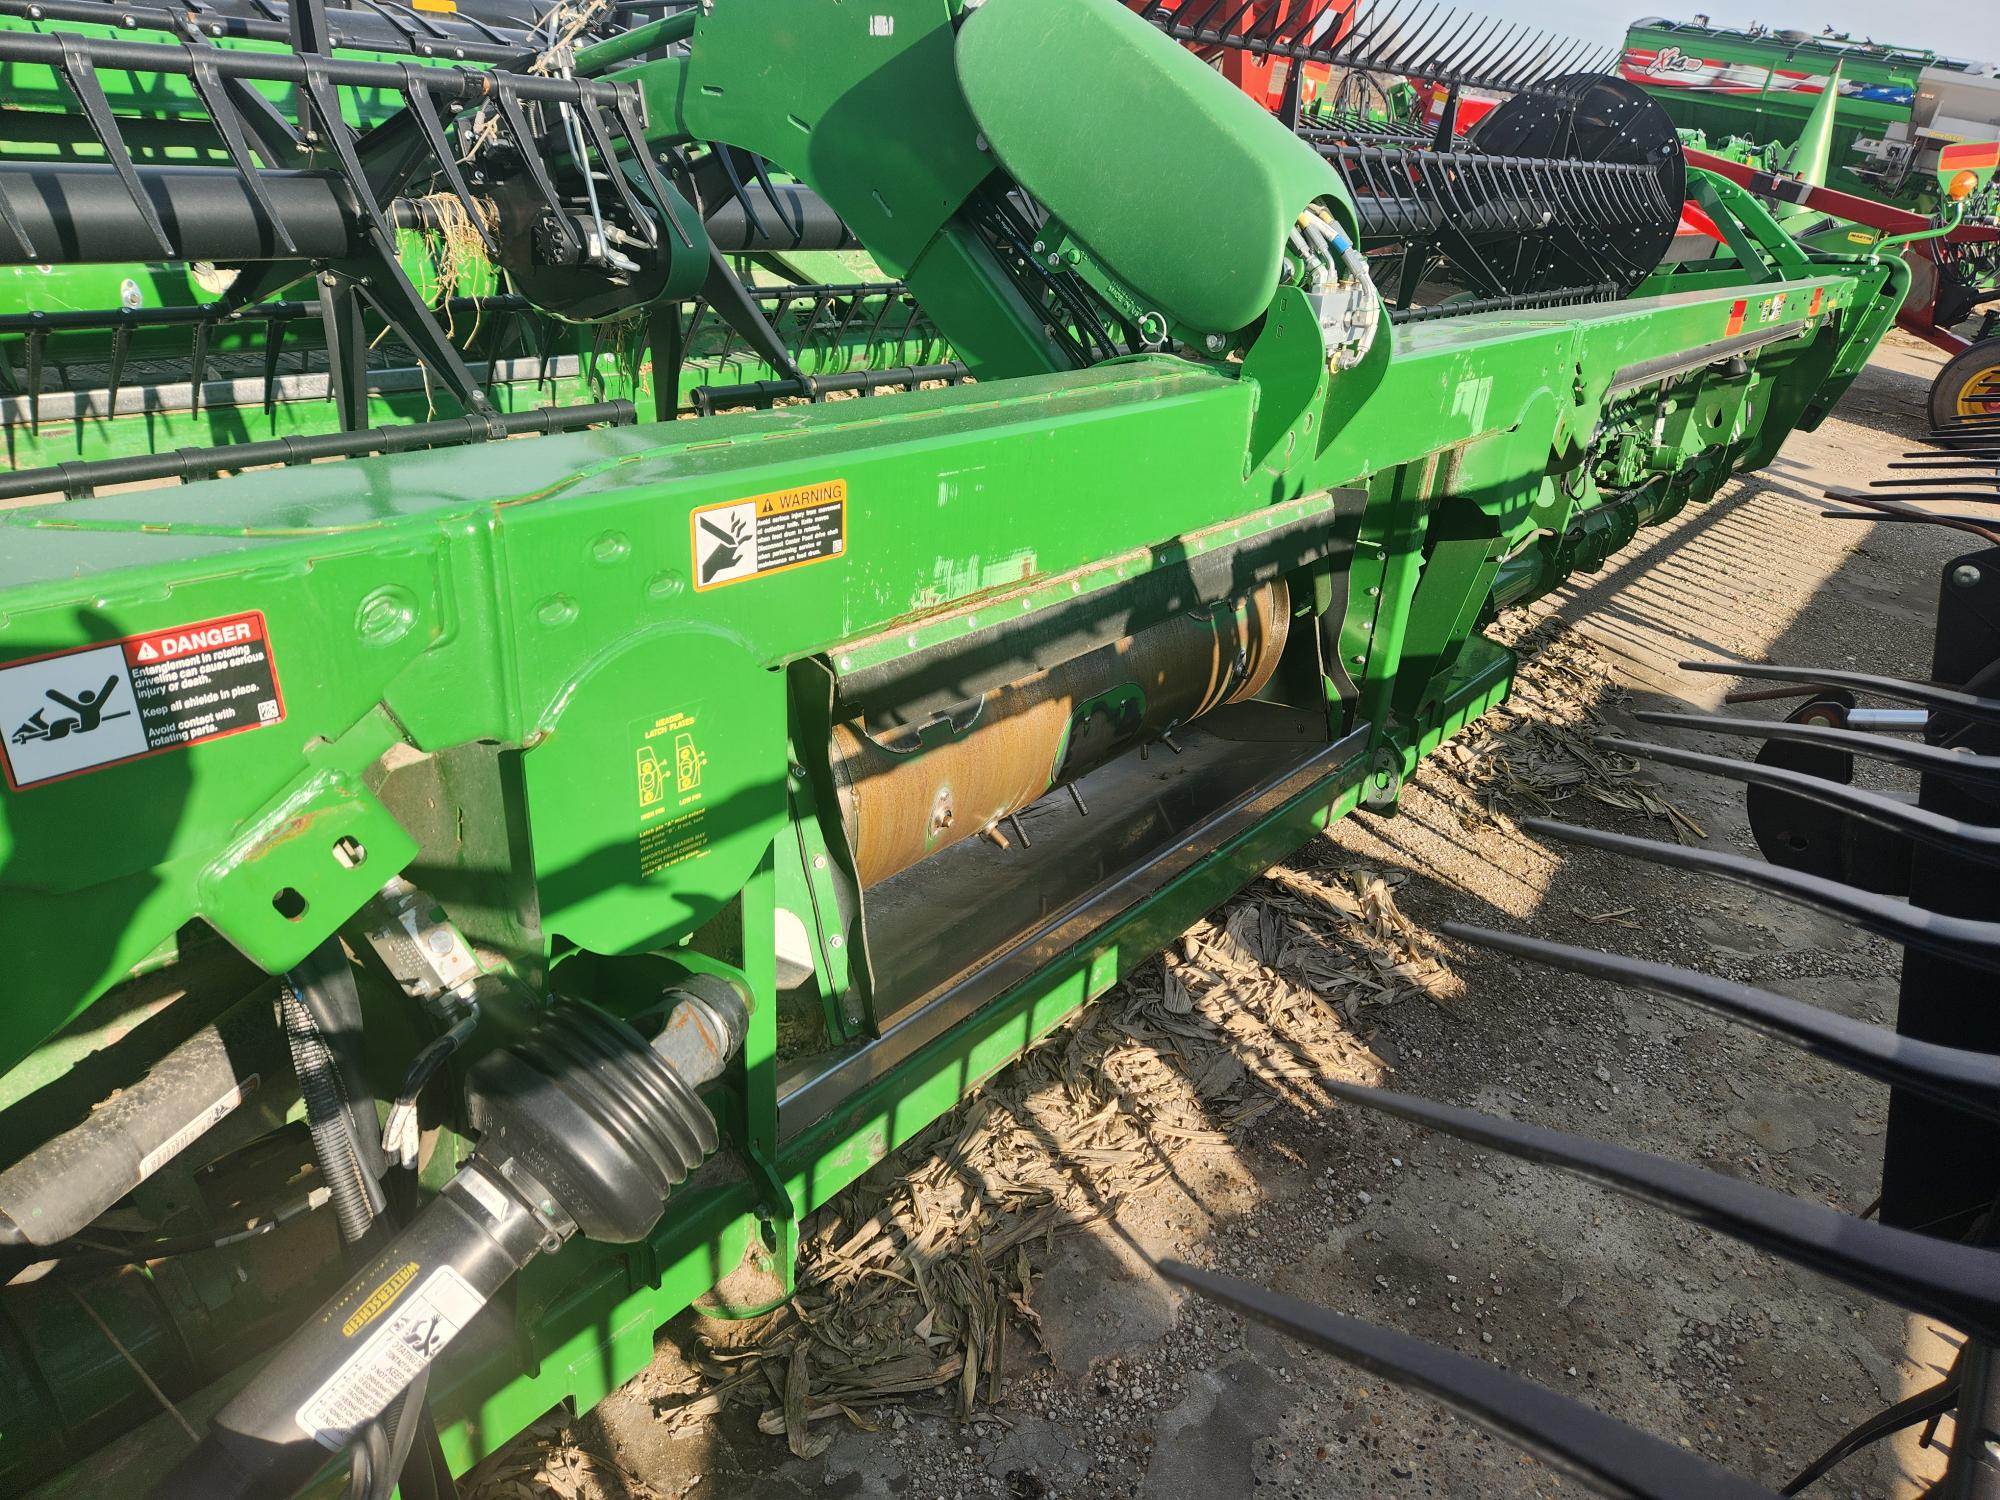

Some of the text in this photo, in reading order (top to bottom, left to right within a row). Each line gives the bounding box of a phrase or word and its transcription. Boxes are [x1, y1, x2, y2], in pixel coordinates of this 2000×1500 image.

[779, 485, 842, 509] WARNING
[791, 511, 805, 520] injury
[161, 623, 251, 656] DANGER
[132, 644, 250, 678] Entanglement in rotating
[135, 652, 265, 689] driveline can cause serious
[137, 674, 212, 699] injury or death.
[143, 683, 260, 719] Keep all shields in place.
[148, 708, 236, 737] Avoid contact with
[644, 716, 695, 739] LATCH PLATES
[655, 712, 684, 728] HEADER
[150, 724, 219, 748] rotating parts.
[639, 828, 655, 838] Latch
[672, 837, 695, 850] HEADER
[694, 832, 706, 840] MAY
[641, 858, 662, 870] DETACH
[662, 851, 678, 862] FROM
[678, 840, 702, 854] COMBINE
[343, 1262, 420, 1336] WALTERSCHEID
